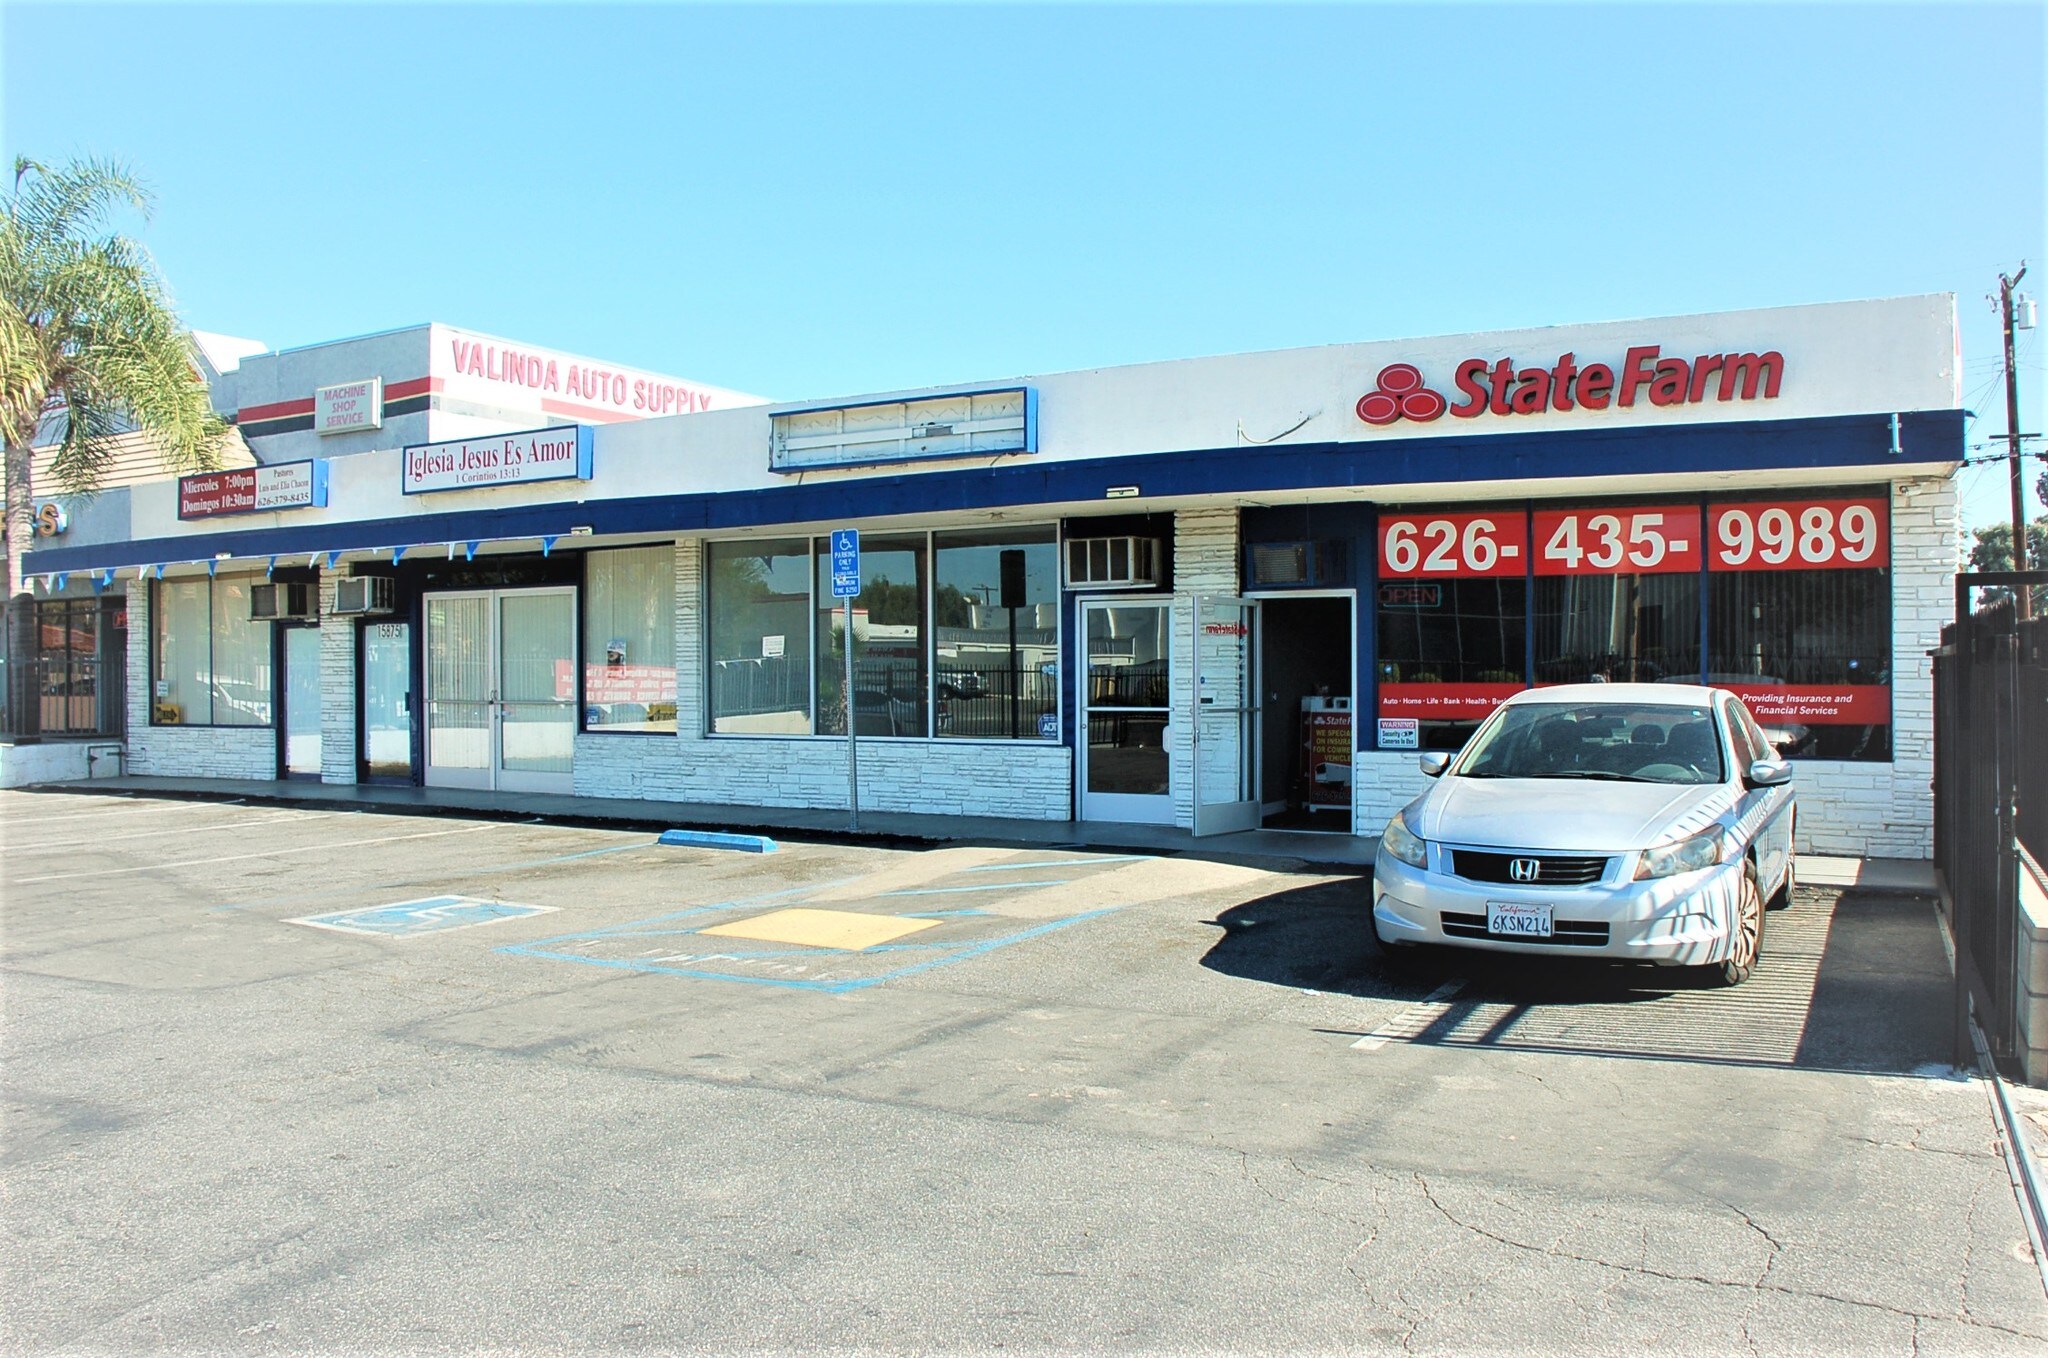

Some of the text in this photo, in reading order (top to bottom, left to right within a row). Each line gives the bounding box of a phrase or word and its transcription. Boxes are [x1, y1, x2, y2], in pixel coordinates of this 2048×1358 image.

[452, 339, 712, 415] VALINDA AUTO SUPPLY
[324, 385, 366, 401] MACHINE
[332, 400, 357, 414] SHOP
[326, 412, 364, 428] SERVICE
[408, 438, 575, 482] Iglesia Jesus Es Amor
[273, 468, 294, 478] Pastores
[455, 468, 521, 484] 1 Corintios 13:13
[183, 475, 255, 494] Miercoles 7:00pm
[258, 479, 309, 493] Luis and Elia Chacon
[183, 493, 255, 514] Domingos 10:30am
[257, 492, 309, 507] 626-379-8435
[1384, 504, 1878, 573] 626- 435- 9989
[1378, 588, 1437, 604] OPEN
[1383, 697, 1399, 705] Auto
[1402, 697, 1422, 705] Home
[1426, 697, 1439, 705] Life
[1443, 697, 1461, 705] Bank
[1465, 697, 1488, 705] Health
[1741, 693, 1854, 704] Providing Insurance and
[1755, 705, 1838, 715] Financial Services
[1043, 722, 1057, 732] ADT
[1381, 720, 1415, 729] WARNING
[1382, 730, 1401, 738] Security
[1498, 904, 1540, 915] California
[1492, 914, 1550, 934] 6KSN214
